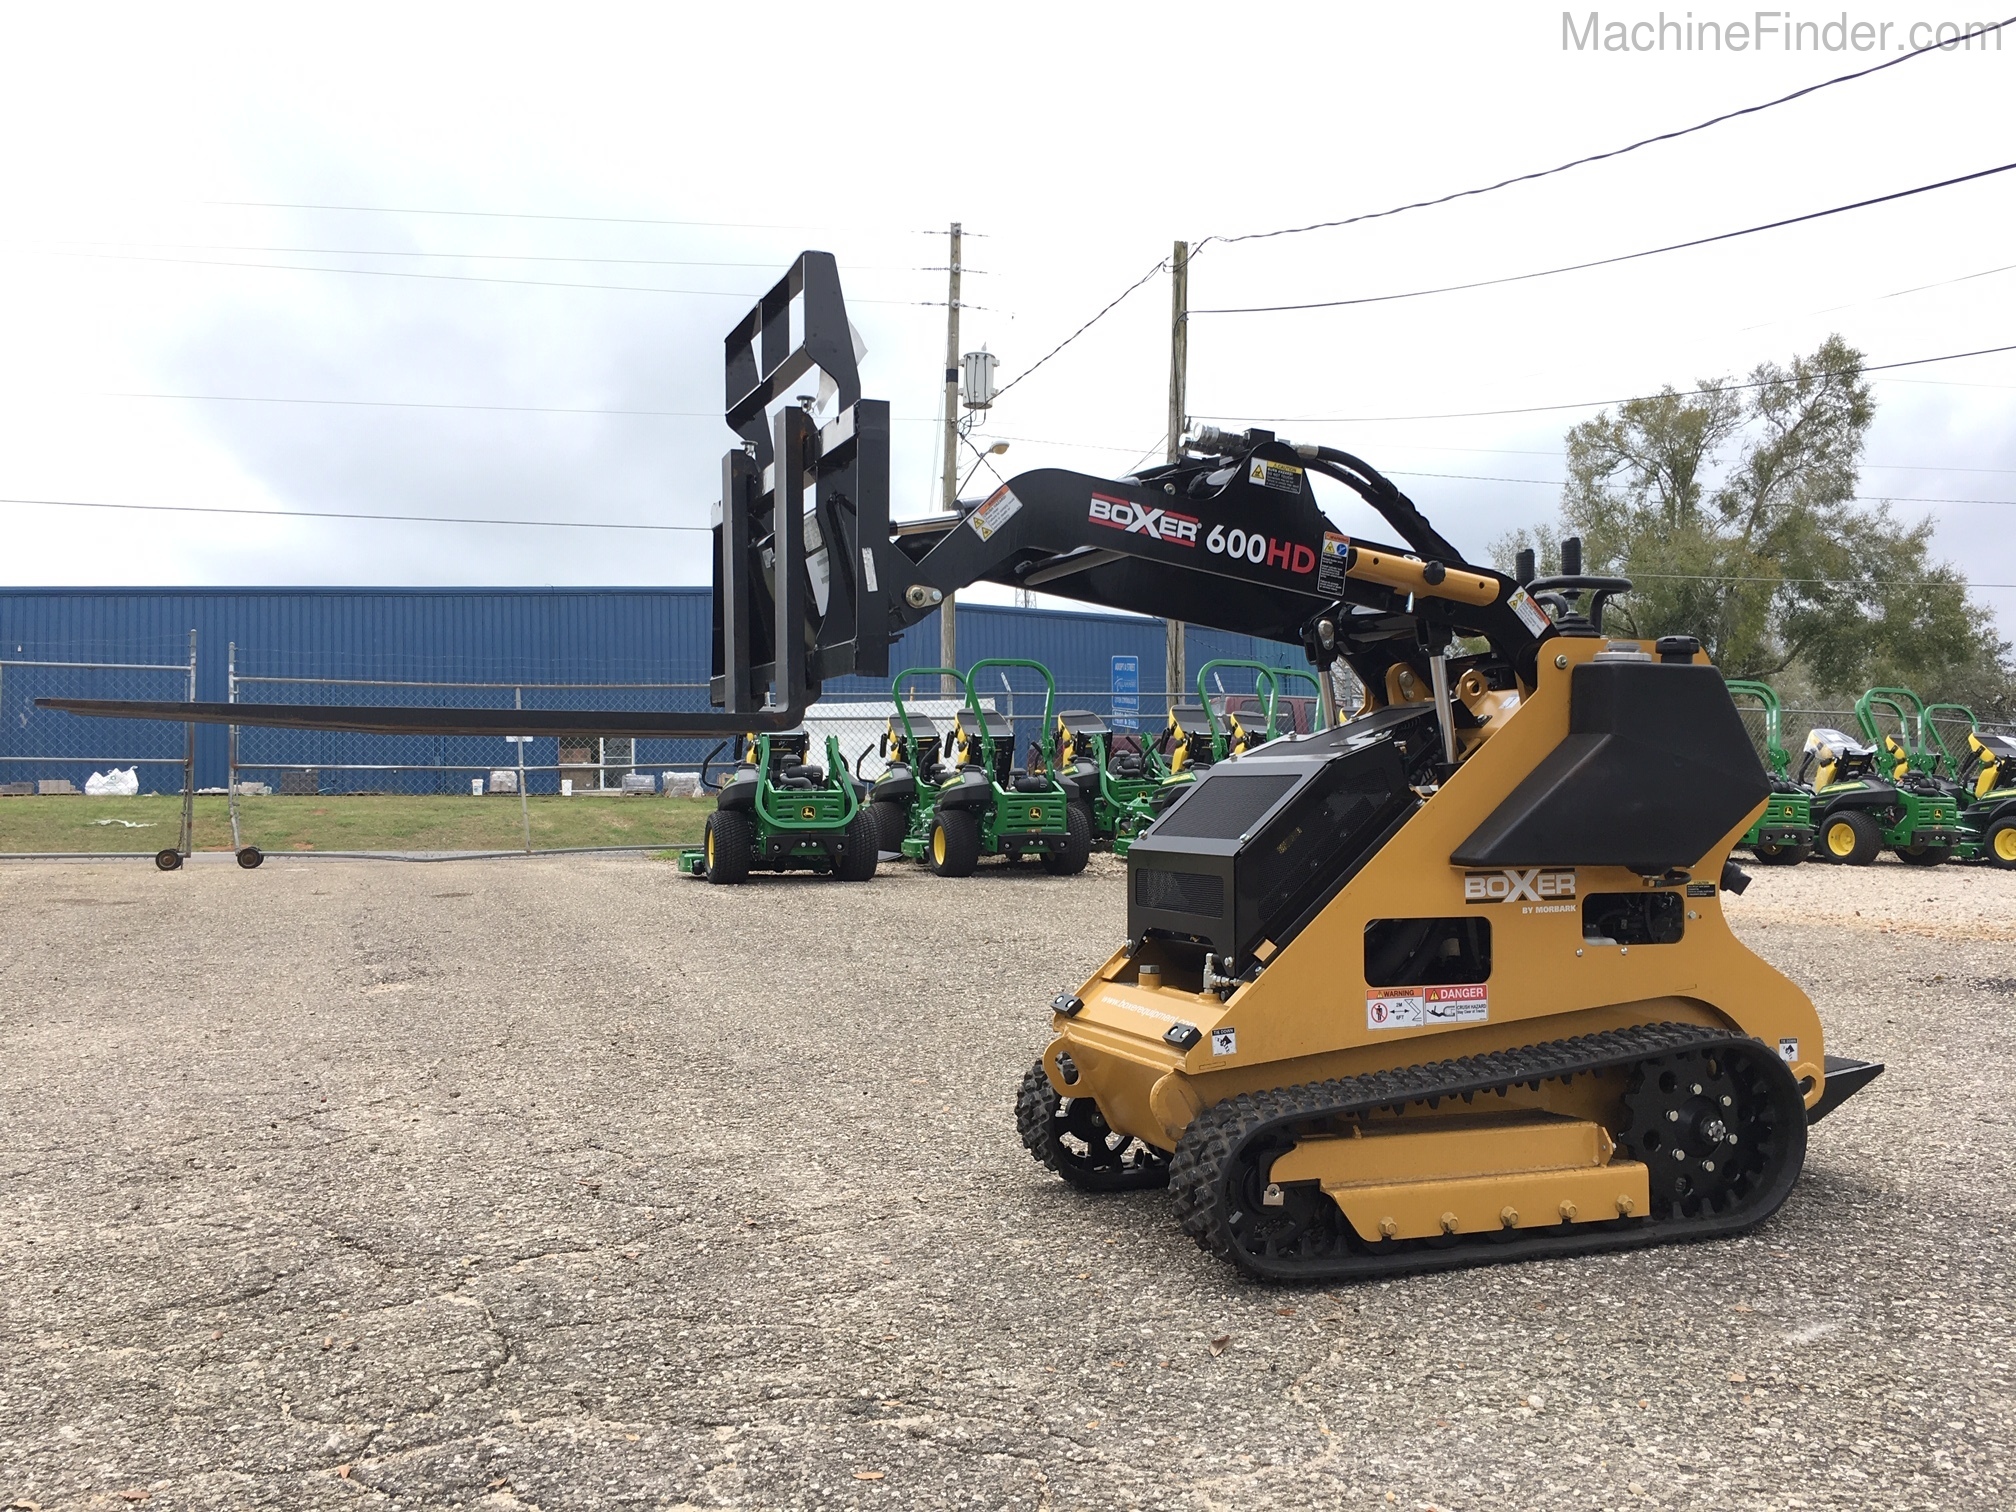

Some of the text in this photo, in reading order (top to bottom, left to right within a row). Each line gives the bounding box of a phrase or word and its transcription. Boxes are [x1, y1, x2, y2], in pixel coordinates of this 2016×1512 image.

[1089, 498, 1202, 542] BOXER
[1206, 525, 1316, 574] 600HD
[1465, 869, 1576, 903] BOXER
[1522, 905, 1576, 914] BY MORBARK
[1441, 988, 1484, 999] DANGER
